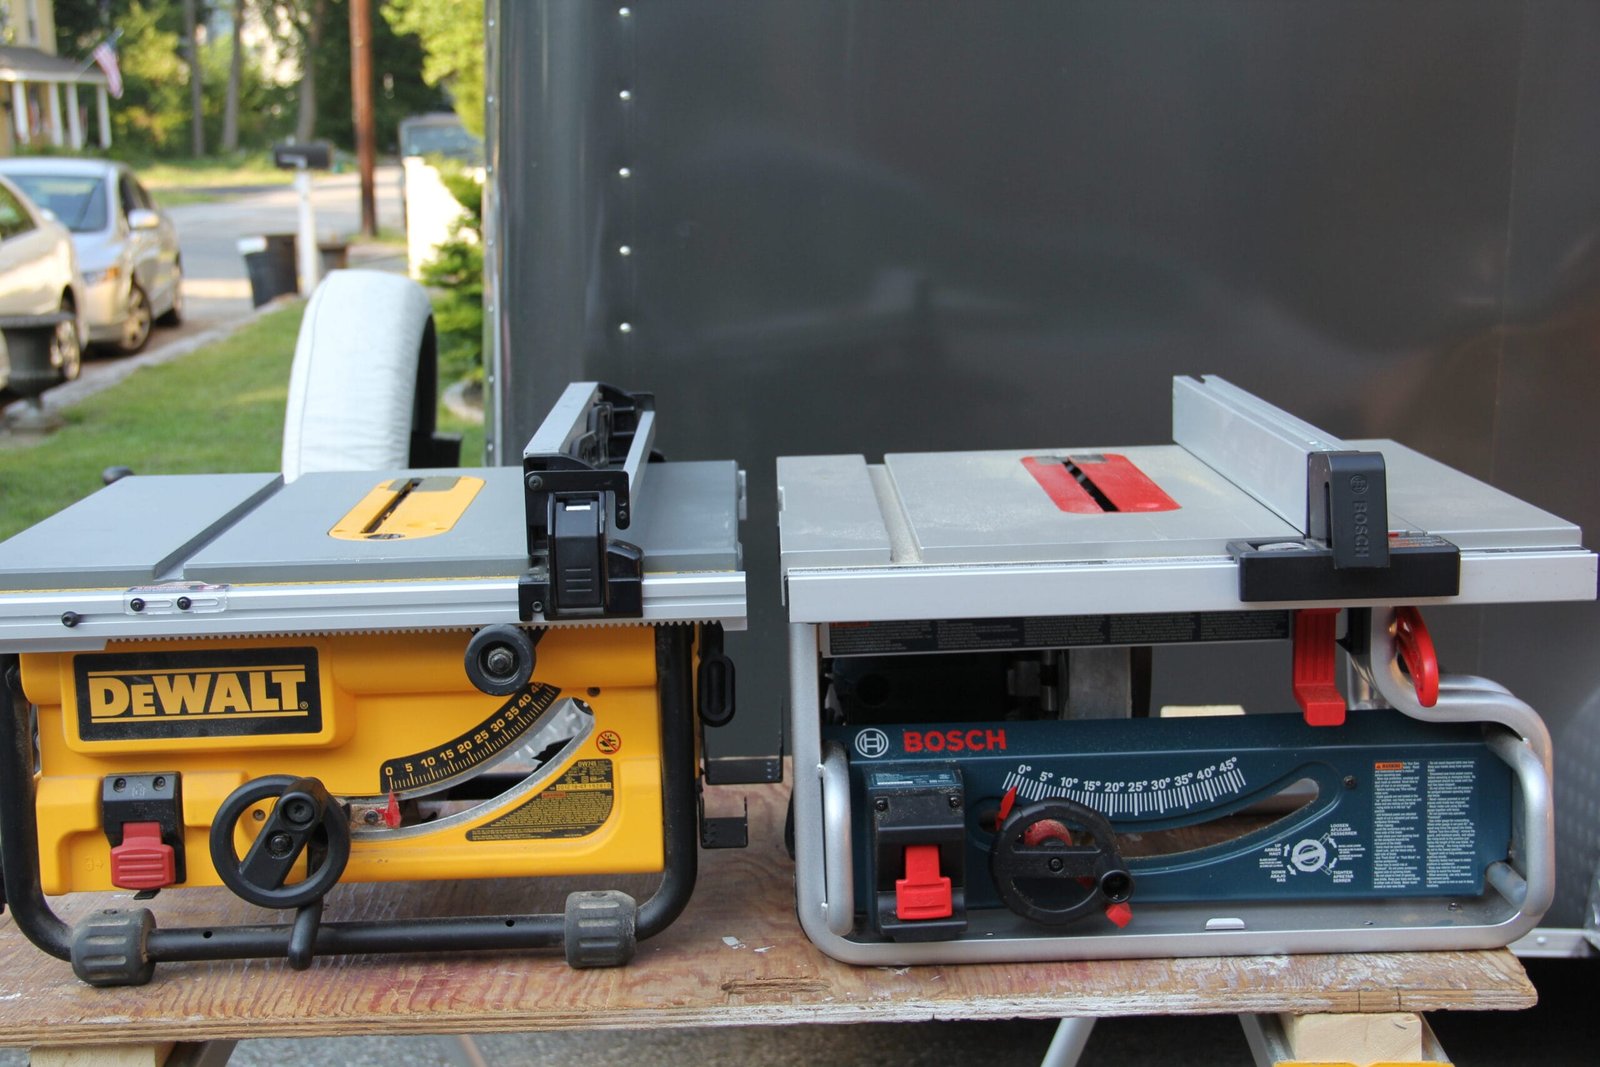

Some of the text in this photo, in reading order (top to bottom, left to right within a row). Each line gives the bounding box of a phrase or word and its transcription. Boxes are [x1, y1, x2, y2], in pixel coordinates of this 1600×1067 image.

[1353, 500, 1370, 558] BOSCH
[385, 766, 394, 776] 0
[404, 762, 414, 773] 5
[420, 756, 436, 768] 10
[439, 748, 455, 761] 15
[456, 740, 473, 754] 20
[474, 730, 490, 744] 25
[490, 719, 506, 733] 30
[504, 706, 520, 720] 35
[517, 693, 532, 709] 40
[903, 728, 1007, 753] BOSCH
